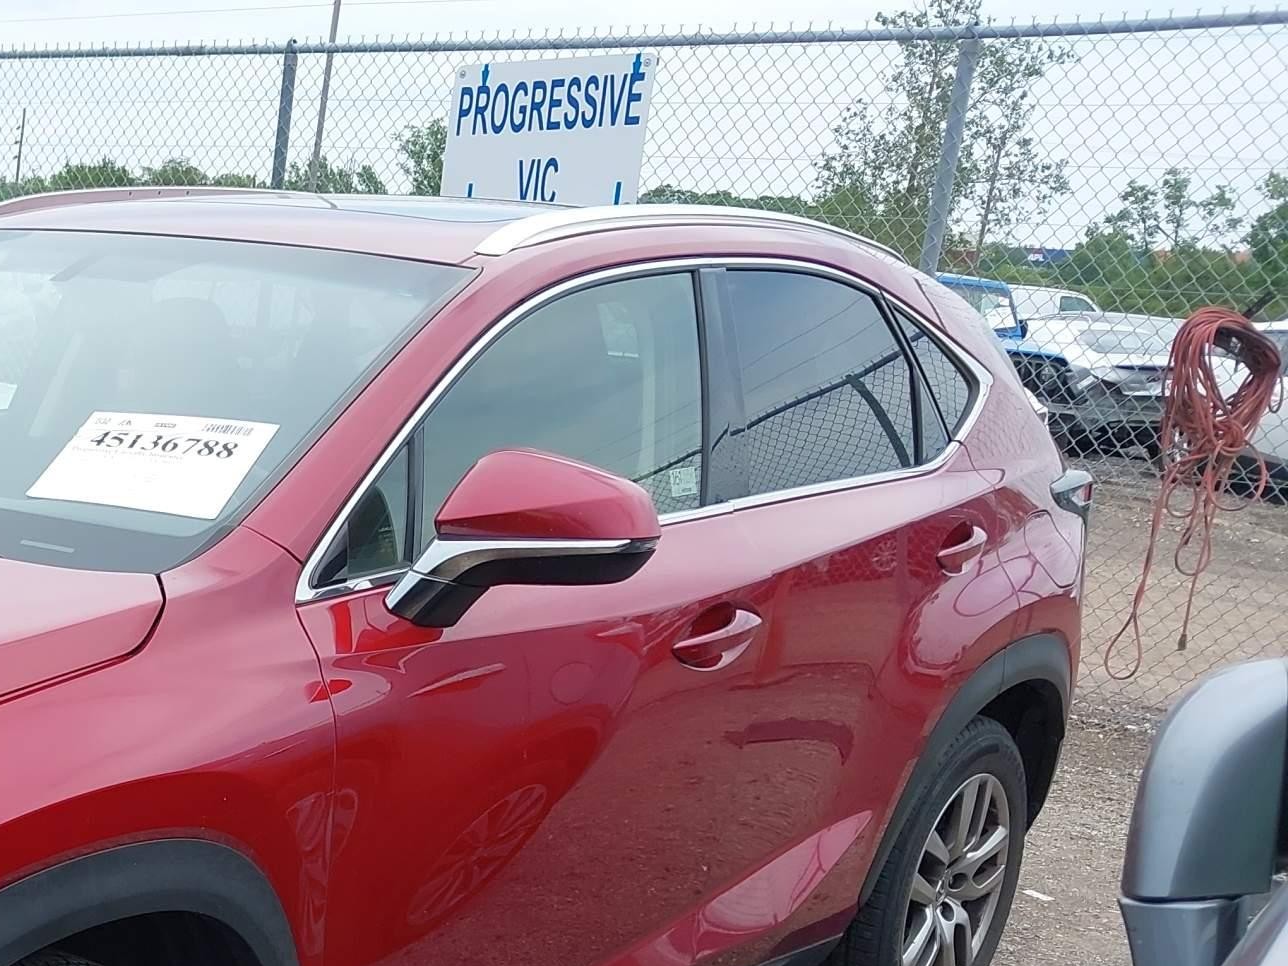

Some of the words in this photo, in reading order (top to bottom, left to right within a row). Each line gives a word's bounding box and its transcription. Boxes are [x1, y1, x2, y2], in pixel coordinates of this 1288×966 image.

[456, 72, 646, 136] PROGRESSIVE
[519, 157, 559, 202] VIC
[90, 429, 239, 460] 45136788
